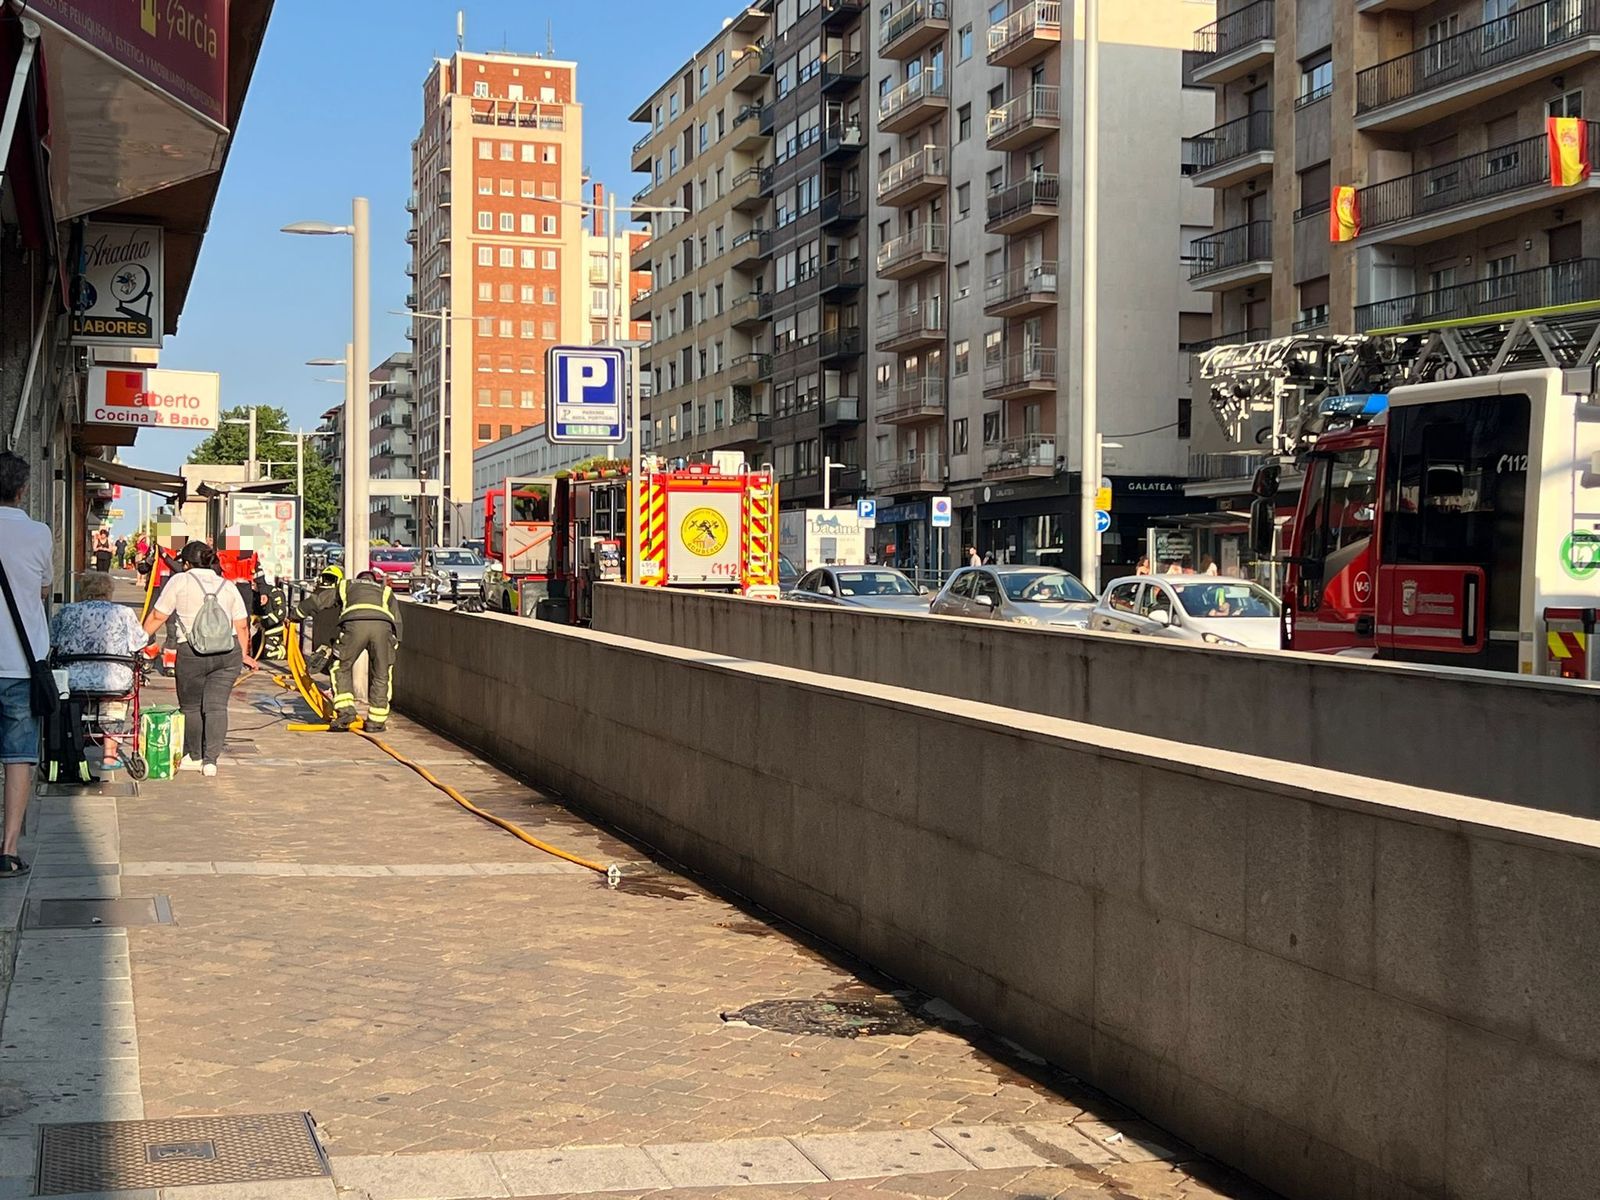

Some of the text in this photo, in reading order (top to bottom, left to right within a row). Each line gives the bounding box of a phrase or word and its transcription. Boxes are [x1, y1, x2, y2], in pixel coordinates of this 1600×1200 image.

[58, 1, 69, 18] DE
[116, 36, 144, 65] ESTETICA
[84, 228, 151, 267] Ariadna
[73, 319, 147, 335] LABORES
[567, 357, 608, 403] P
[95, 408, 210, 426] Cocina & Baño
[1507, 455, 1528, 472] 112
[1128, 482, 1173, 491] GALATEA
[861, 502, 873, 517] P
[716, 563, 738, 575] 112
[1356, 581, 1370, 593] V-5
